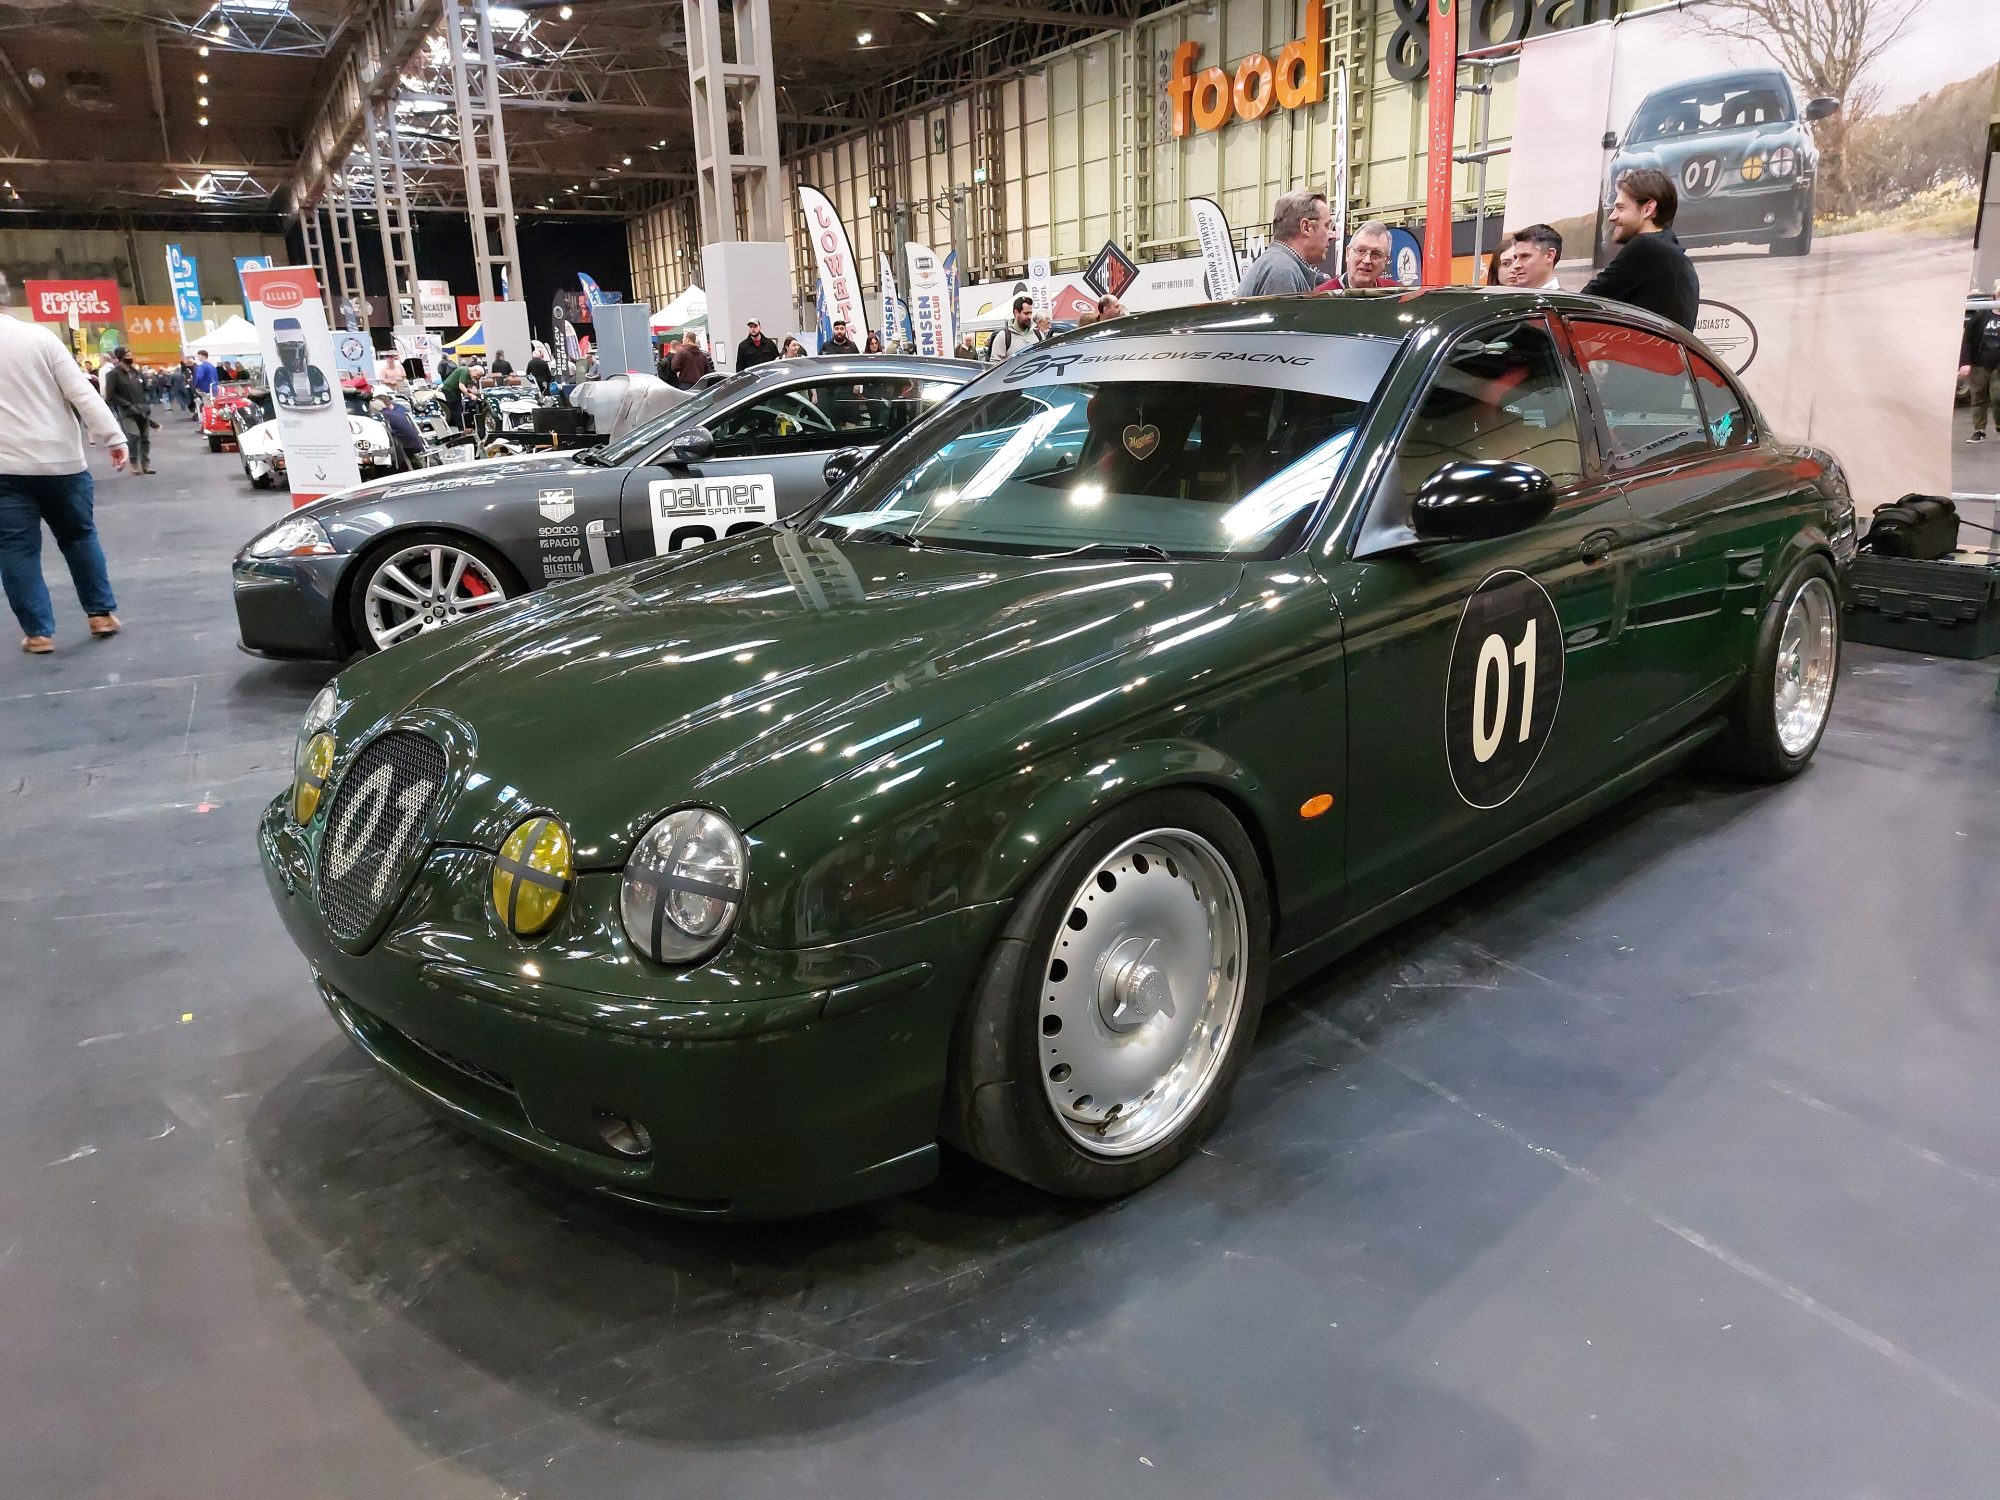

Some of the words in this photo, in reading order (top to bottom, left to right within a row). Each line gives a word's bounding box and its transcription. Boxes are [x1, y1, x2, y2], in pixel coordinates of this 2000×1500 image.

[1168, 0, 1326, 138] food
[1684, 159, 1717, 190] 01
[41, 290, 98, 303] practical
[42, 301, 111, 315] CLASICS
[421, 304, 452, 312] NCASTER
[932, 295, 941, 321] CLUB
[917, 295, 936, 356] ENSEN
[932, 324, 944, 357] WNERS
[560, 331, 568, 371] Register
[1077, 351, 1209, 365] SWALLOWS
[1211, 352, 1316, 366] RACING
[355, 440, 370, 450] GB
[543, 490, 568, 505] TAG
[660, 484, 764, 518] palmer
[541, 504, 575, 521] HEUER
[707, 506, 744, 516] SPORT
[538, 525, 579, 537] sparco
[549, 537, 580, 548] PAGID
[542, 553, 572, 563] alcon
[543, 562, 584, 575] BILSTEIN
[1473, 617, 1537, 763] 01
[329, 764, 434, 902] 01
